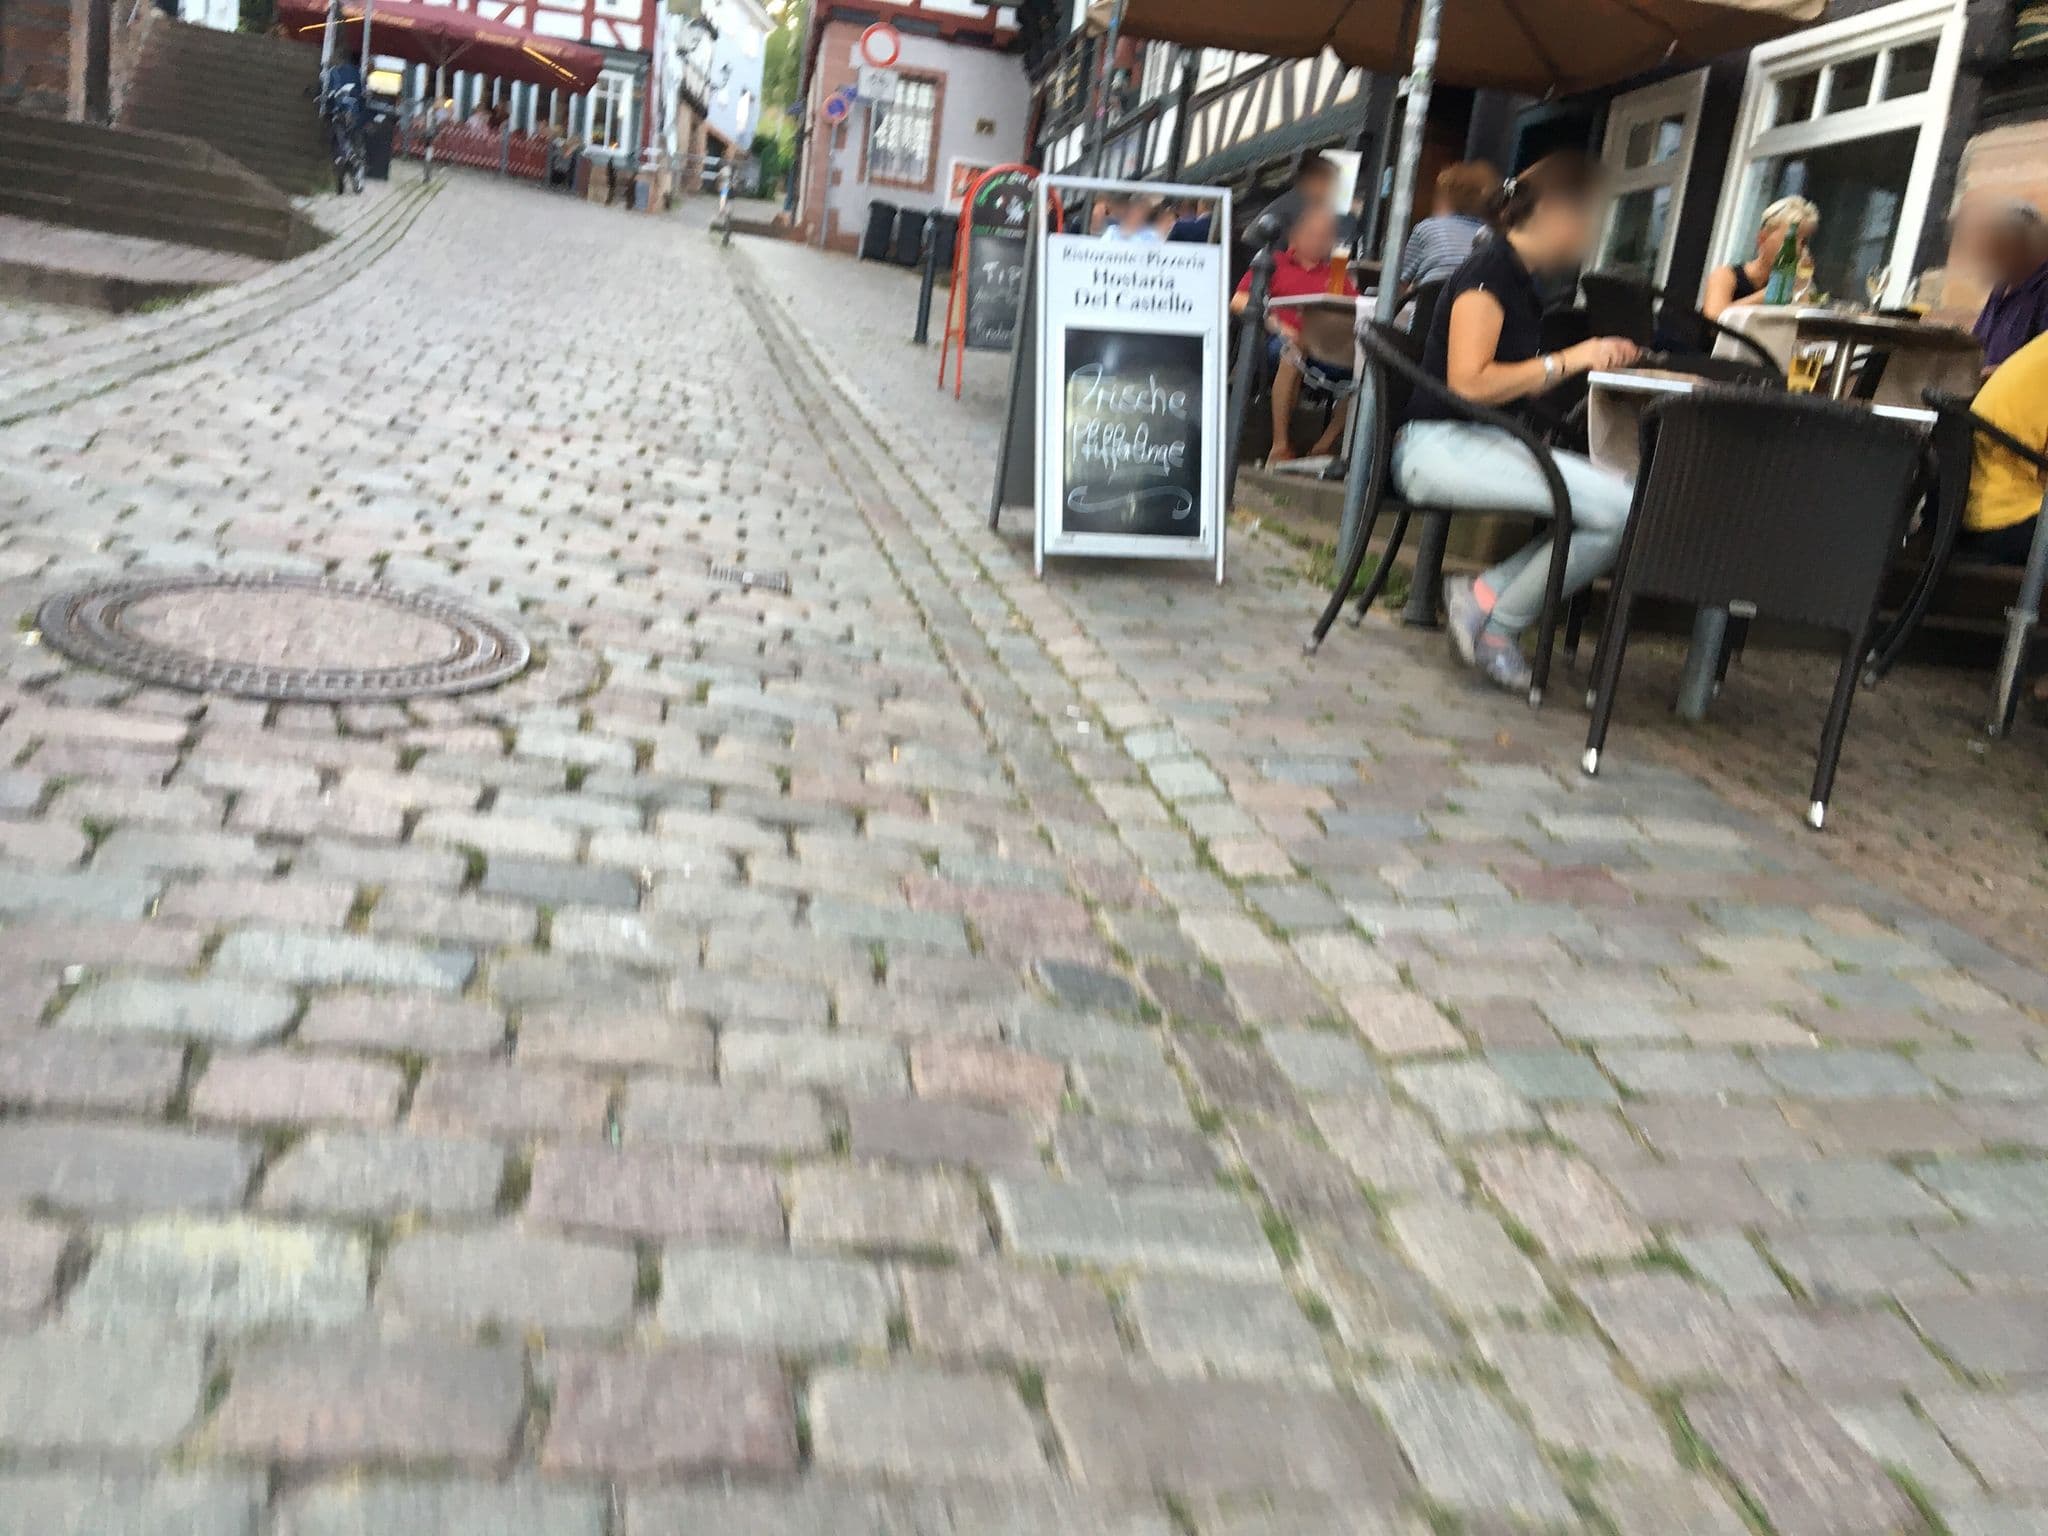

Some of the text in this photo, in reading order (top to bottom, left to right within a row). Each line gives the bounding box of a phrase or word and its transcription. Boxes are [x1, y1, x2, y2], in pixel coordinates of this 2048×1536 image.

[1062, 245, 1206, 271] Ristorante Pizzeria
[1093, 268, 1175, 291] Hostaria
[1074, 288, 1194, 314] Del Castello
